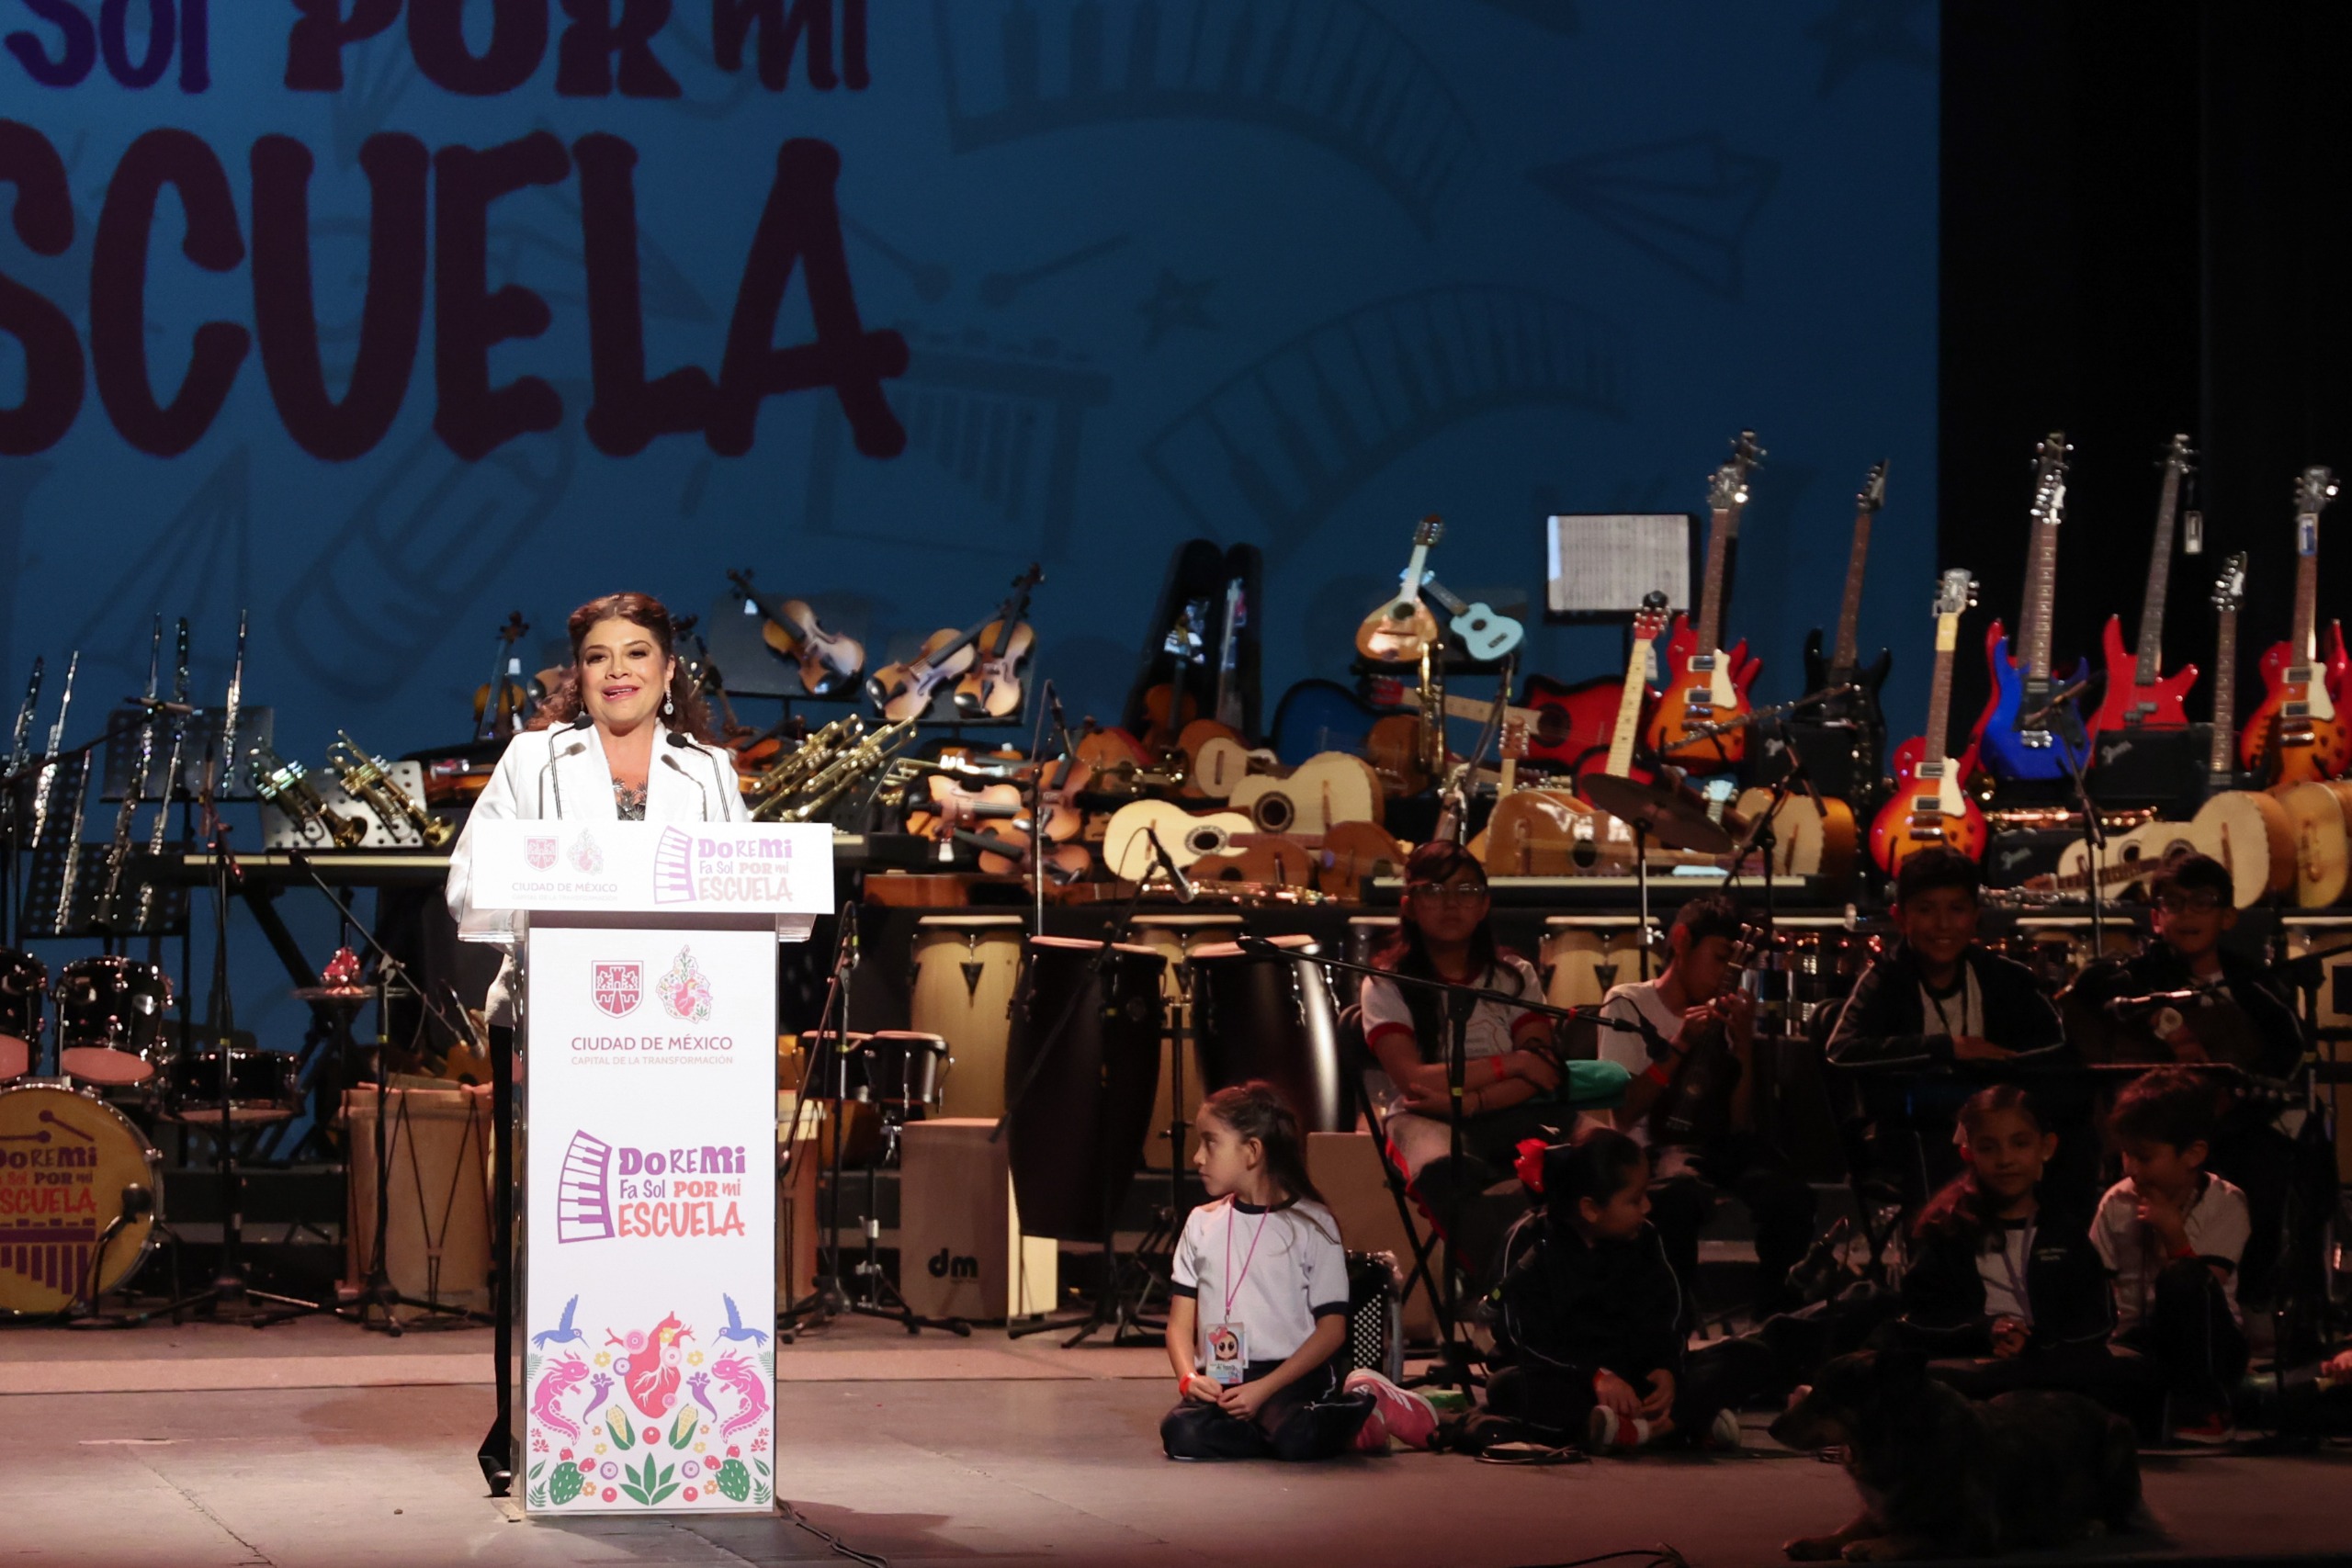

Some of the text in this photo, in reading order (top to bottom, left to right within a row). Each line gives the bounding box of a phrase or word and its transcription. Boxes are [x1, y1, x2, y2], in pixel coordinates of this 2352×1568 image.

[283, 0, 682, 97] POR
[699, 860, 789, 874] Fa Sol POR mi
[512, 882, 617, 893] CIUDAD DE MÉXICO
[698, 875, 793, 902] ESCUELA
[571, 1033, 733, 1051] CIUDAD DE MÉXICO
[571, 1055, 733, 1066] CAPITAL DE LA TRANSFORMACIÓN
[34, 1172, 73, 1185] POR
[620, 1179, 741, 1199] Fa Sol POR mi
[618, 1201, 745, 1237] ESCUELA
[928, 1247, 978, 1278] dm
